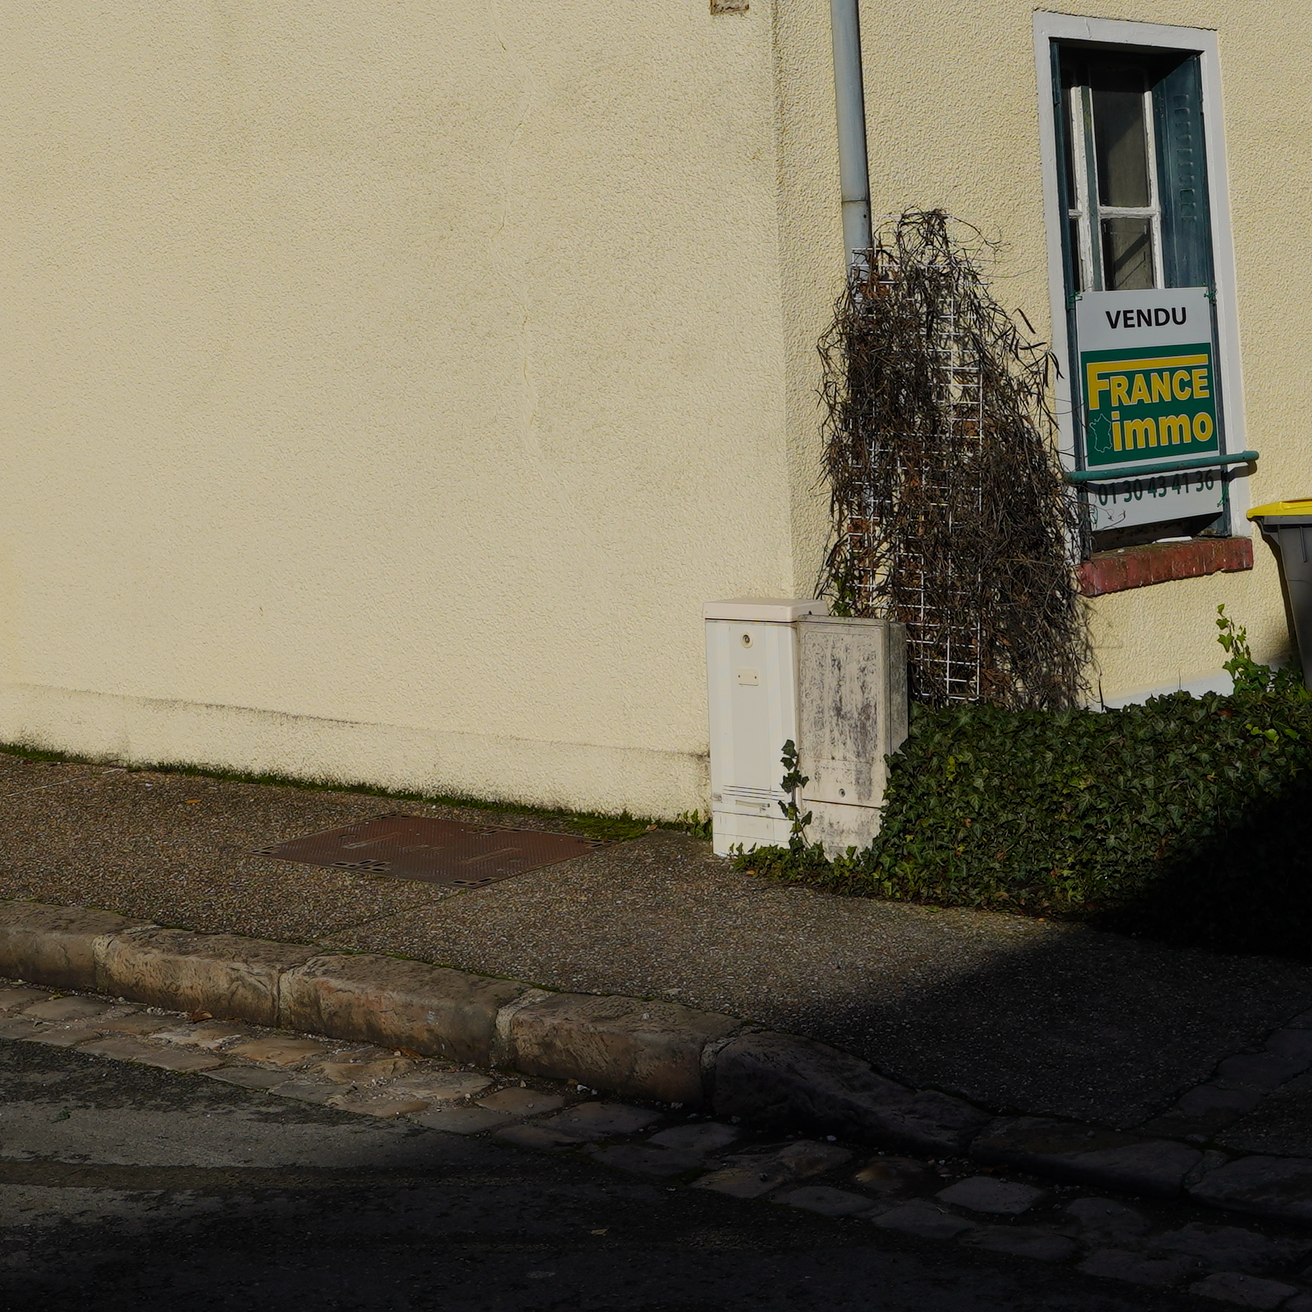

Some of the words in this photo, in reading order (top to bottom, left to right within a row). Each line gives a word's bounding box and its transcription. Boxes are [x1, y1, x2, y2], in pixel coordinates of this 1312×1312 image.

[1105, 306, 1188, 329] VENDU
[1086, 353, 1210, 410] FRANCE
[1111, 410, 1214, 452] immo
[1098, 483, 1117, 506] 01
[1123, 479, 1143, 502] 30
[1148, 476, 1167, 498] 43
[1172, 473, 1190, 495] 41
[1195, 469, 1214, 492] 36
